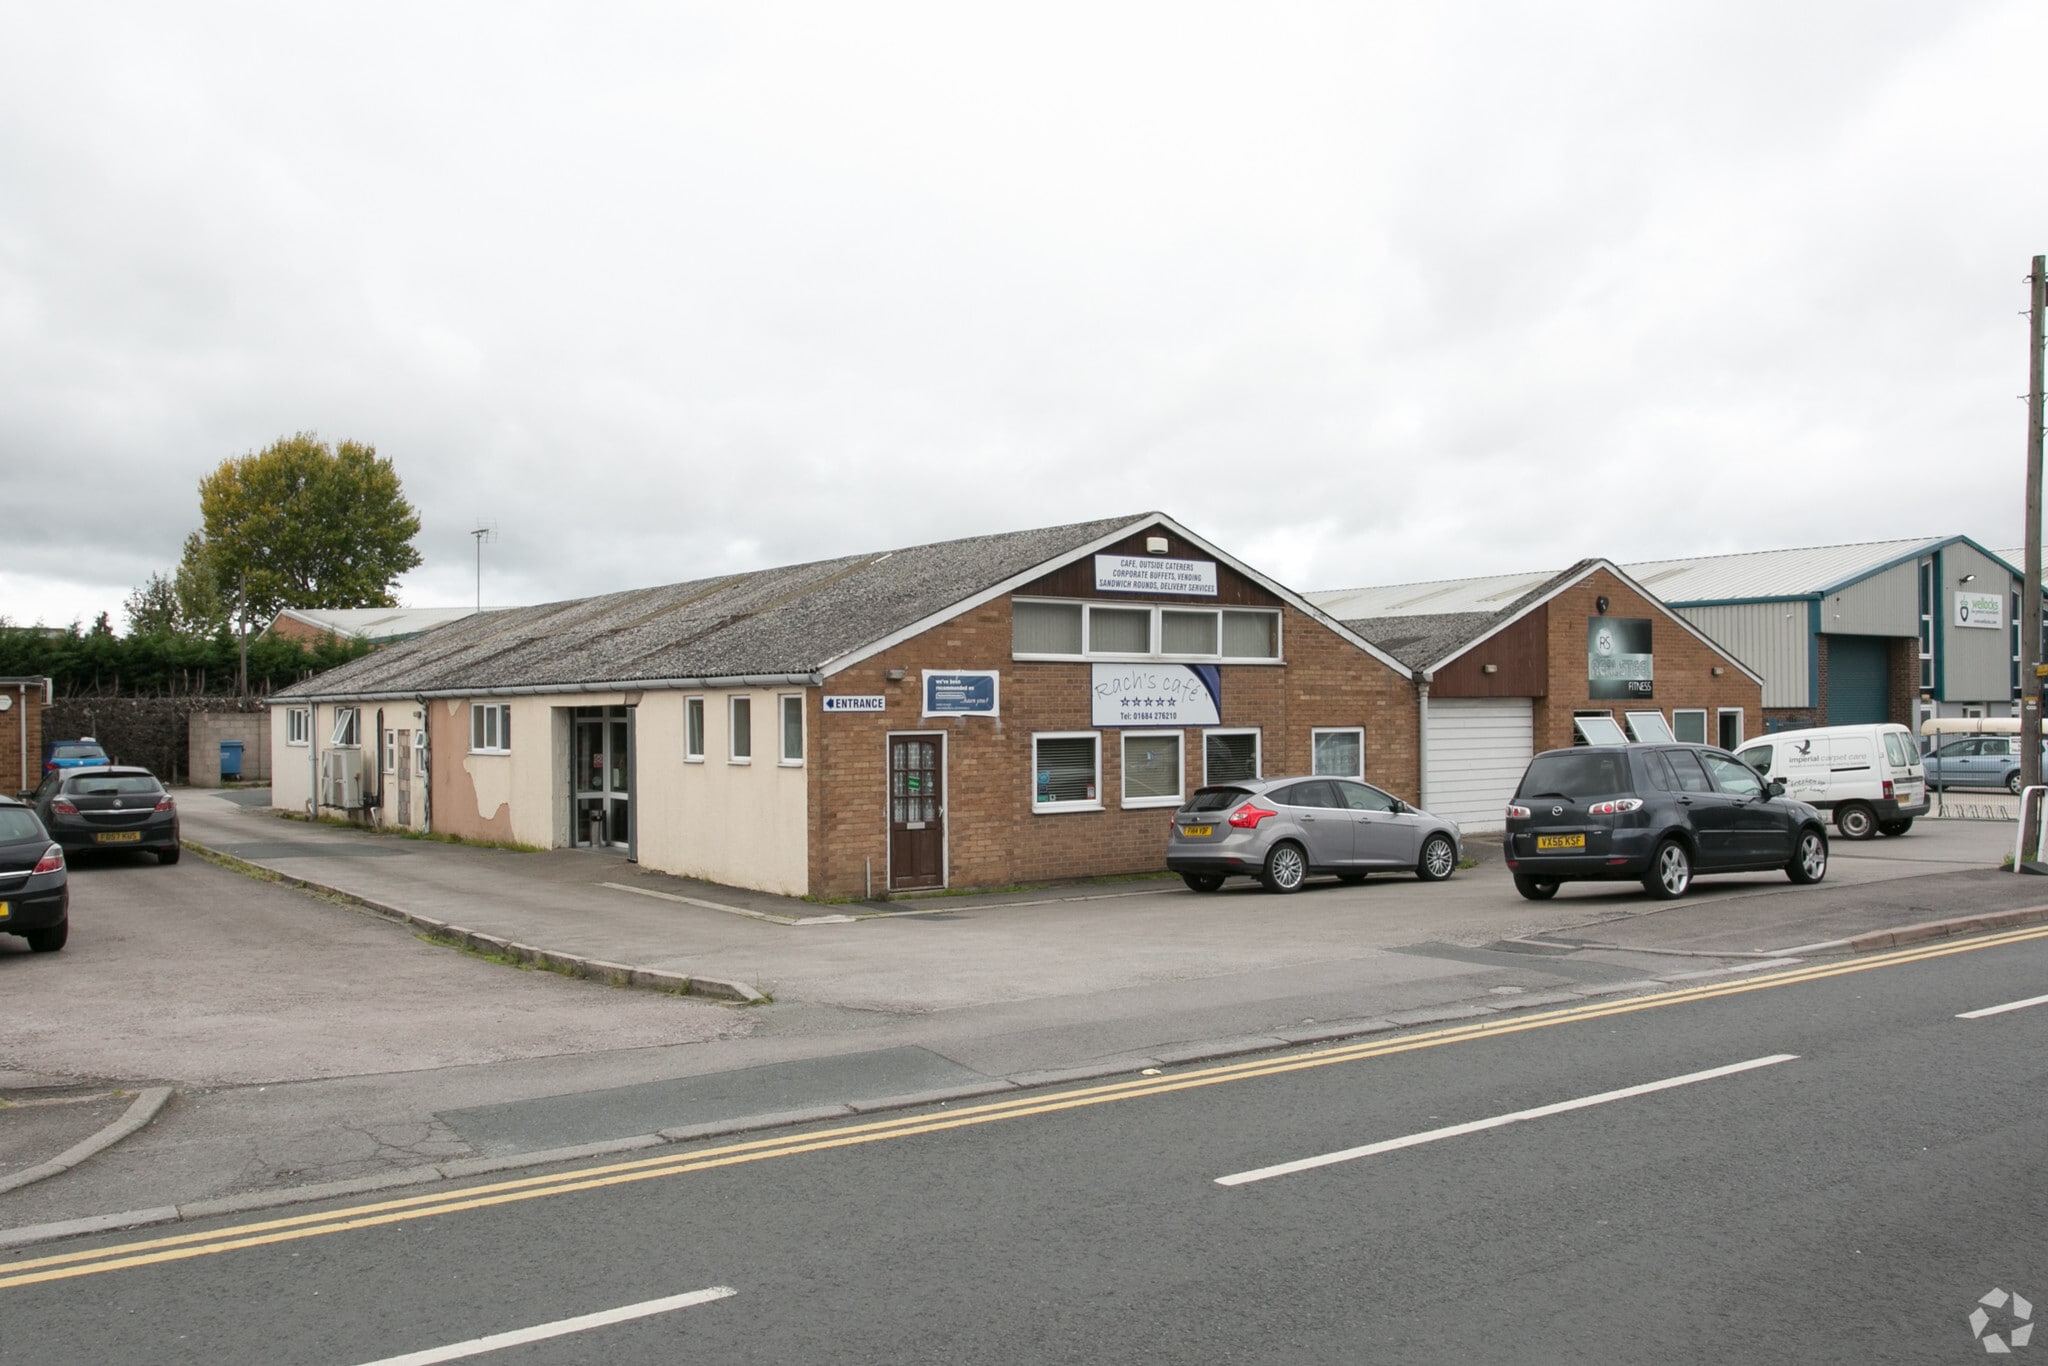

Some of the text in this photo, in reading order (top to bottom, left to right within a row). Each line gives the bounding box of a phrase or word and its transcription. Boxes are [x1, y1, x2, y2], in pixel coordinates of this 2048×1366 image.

[1120, 560, 1194, 571] CAFE, OUTSIDE CATERERS
[1112, 569, 1202, 582] CORPORATE BUFFETS, VENDING
[1099, 579, 1215, 593] SANDWICH ROUNDS, DELIVERY SERVICES
[1094, 669, 1156, 700] Rach's
[1628, 682, 1652, 692] FITNESS
[835, 698, 883, 709] ENTRANCE
[1120, 712, 1177, 720] Tel: 01684 276210
[1789, 755, 1820, 764] imperial
[1820, 754, 1847, 762] carpet
[1541, 836, 1582, 848] VX56 KSF
